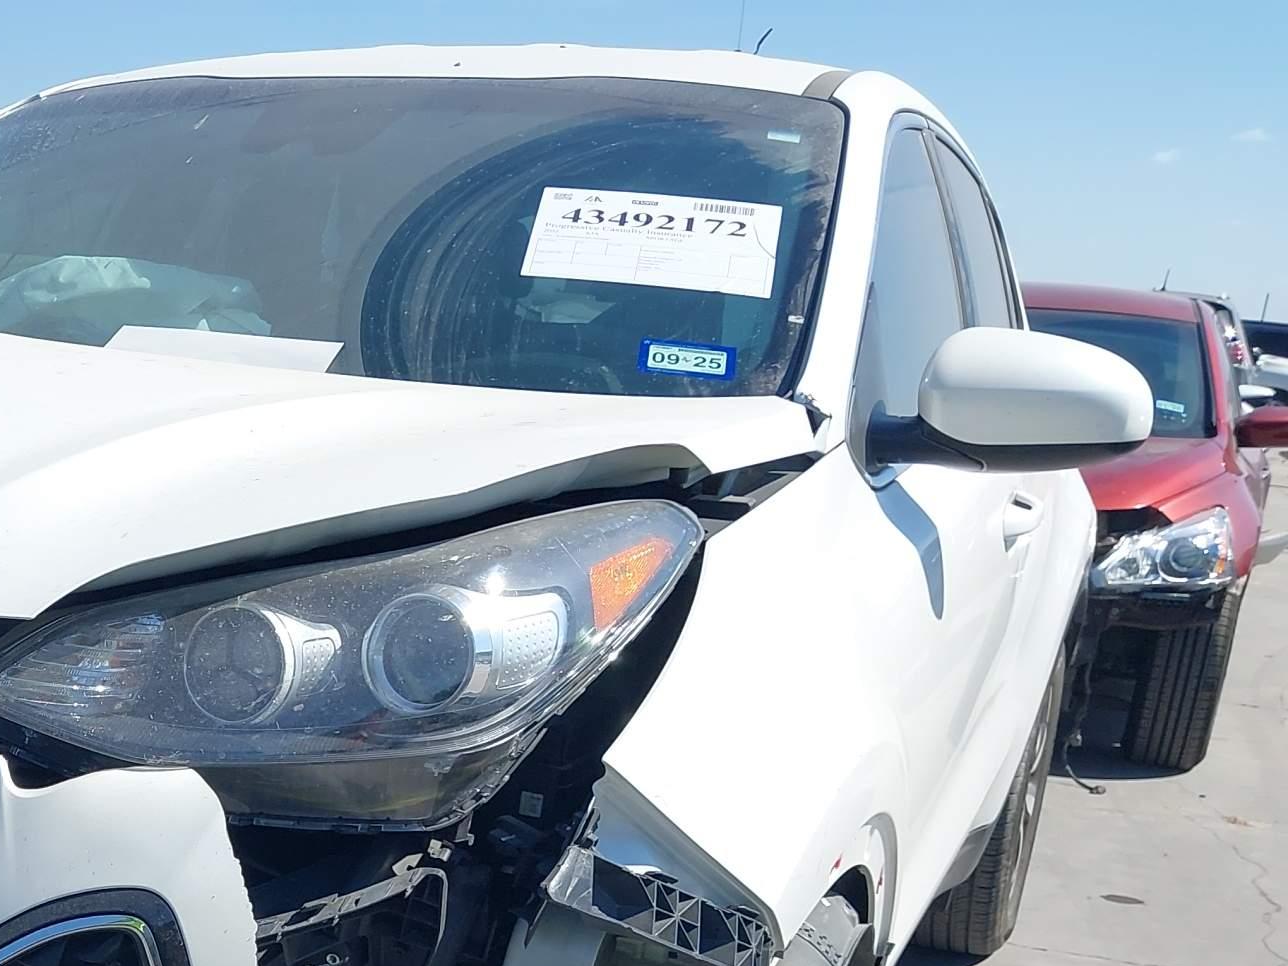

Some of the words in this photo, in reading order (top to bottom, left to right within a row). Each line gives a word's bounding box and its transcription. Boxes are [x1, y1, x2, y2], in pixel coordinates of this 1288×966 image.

[561, 207, 747, 237] 43492172
[652, 351, 680, 365] 09
[693, 356, 722, 369] 25
